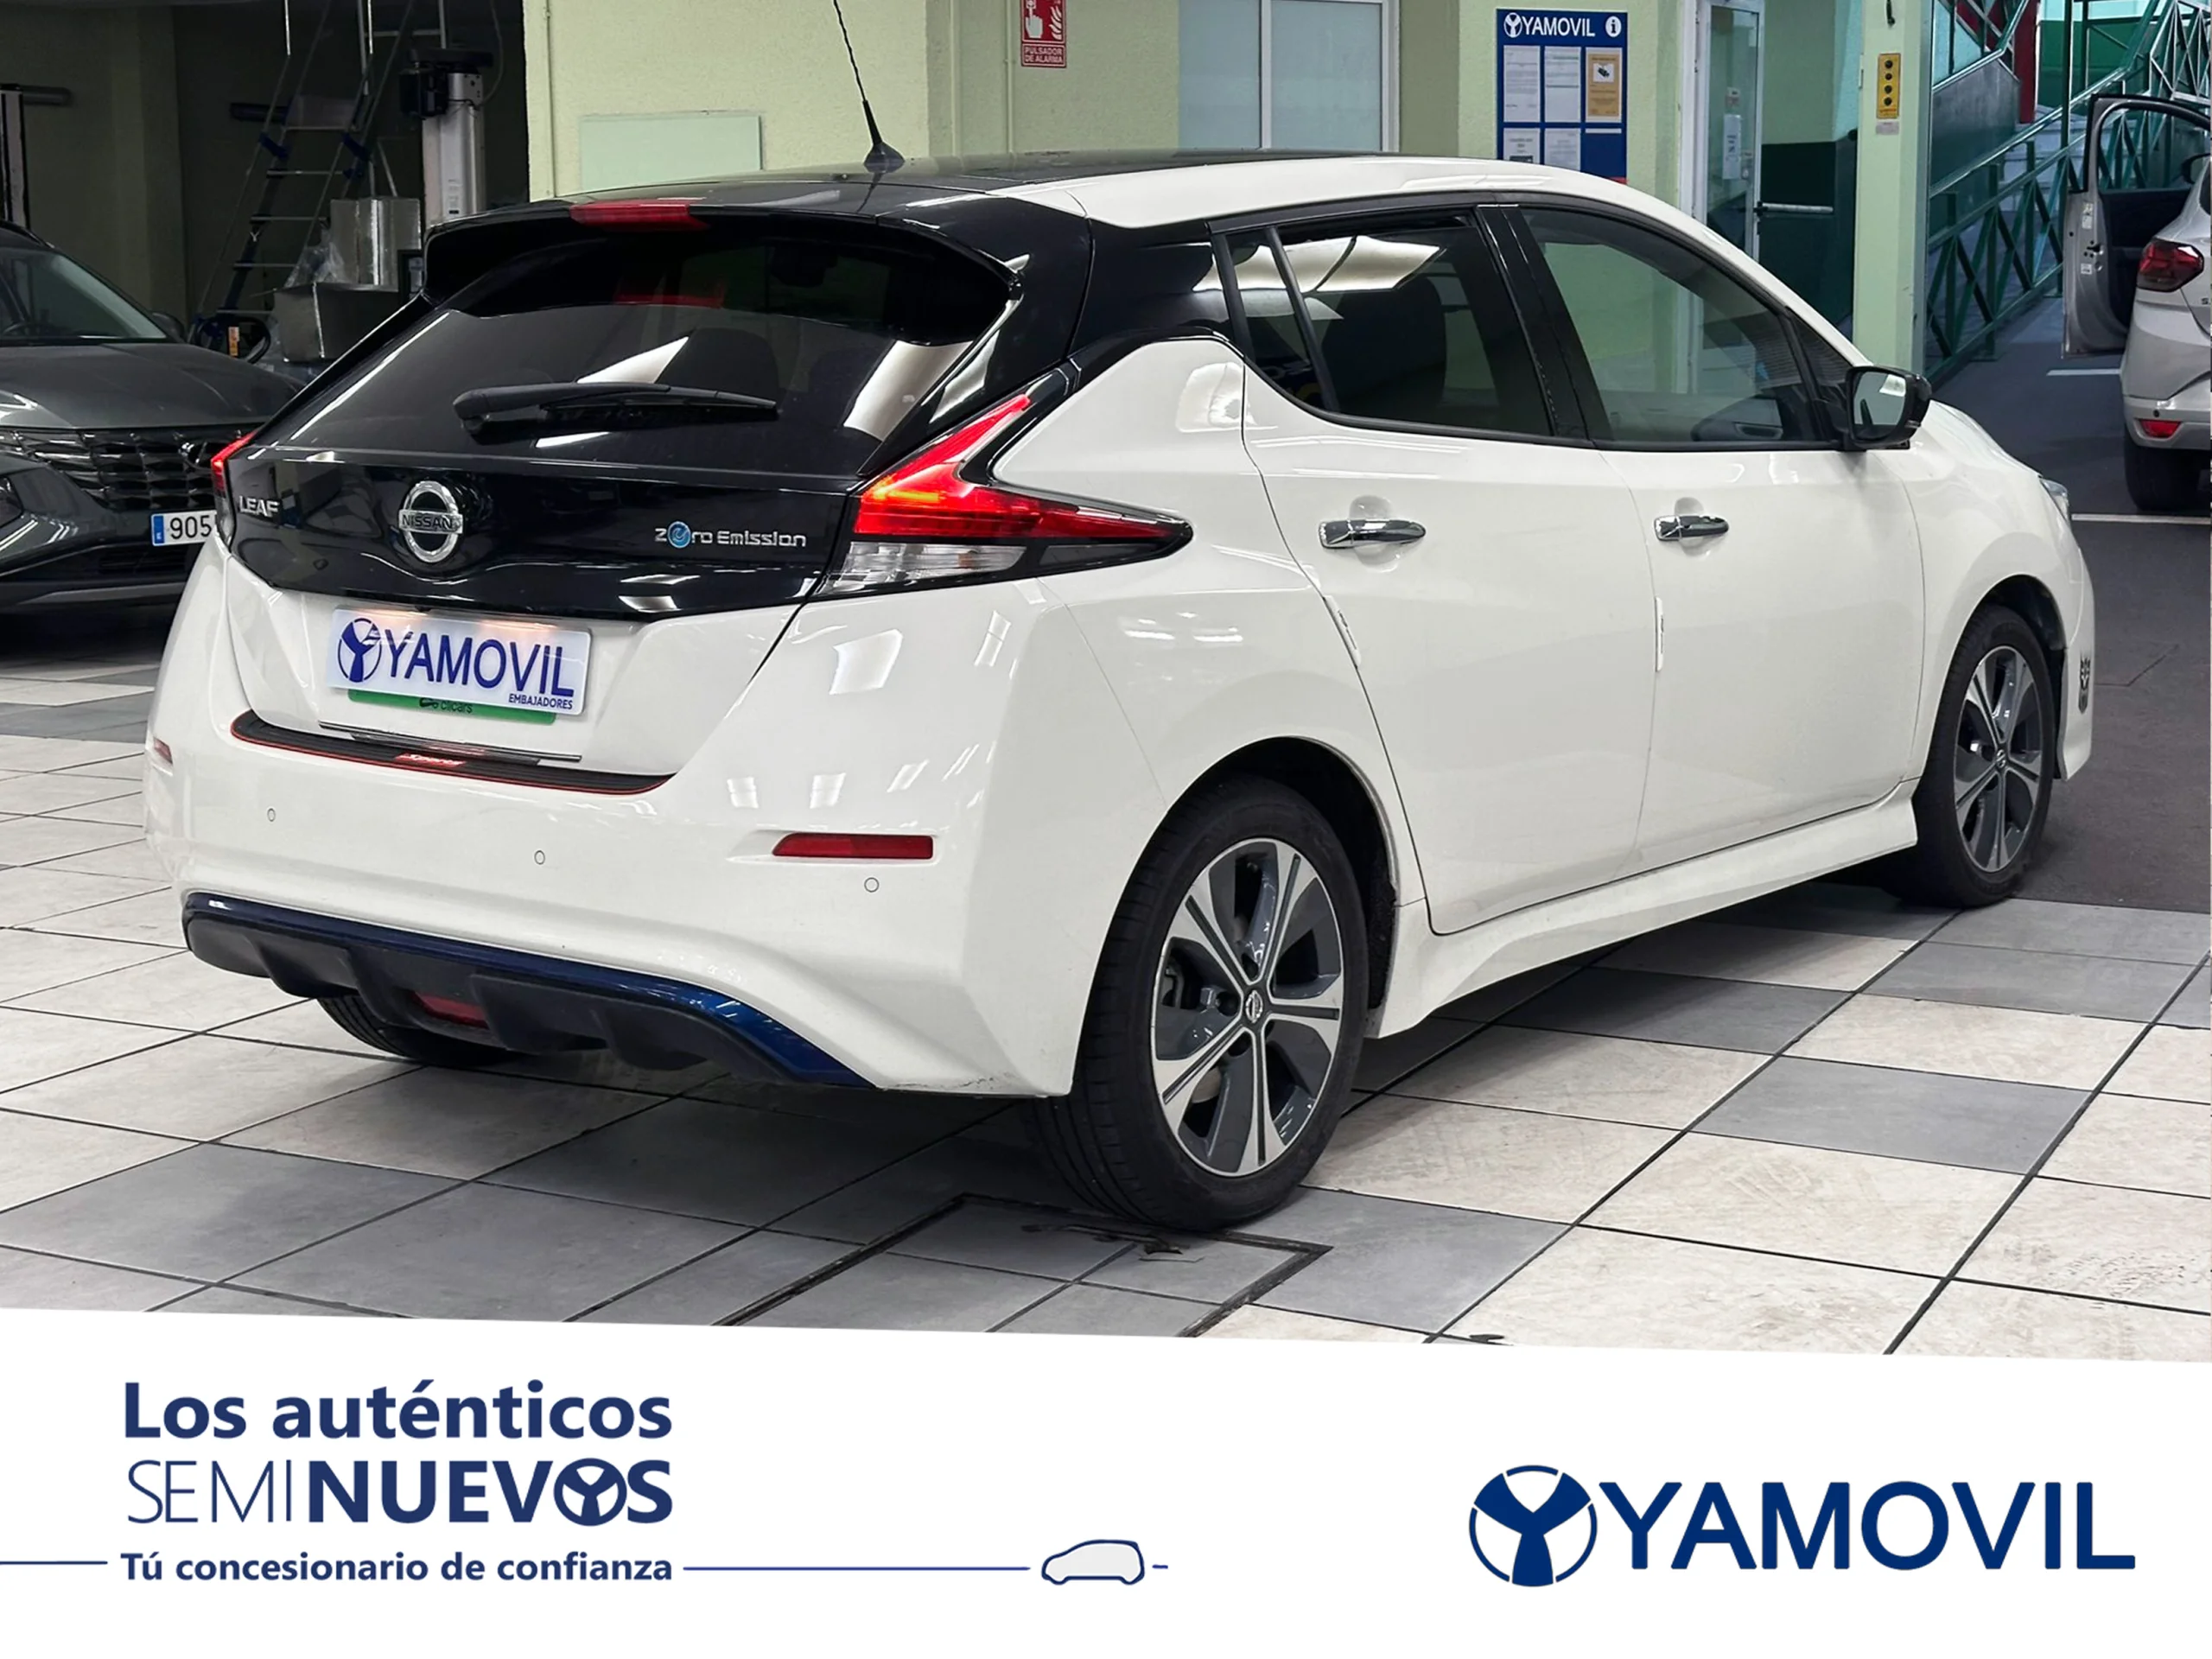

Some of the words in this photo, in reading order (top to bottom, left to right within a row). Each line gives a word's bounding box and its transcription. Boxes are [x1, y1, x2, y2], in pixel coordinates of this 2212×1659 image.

[1522, 16, 1596, 36] YAMOVIL
[1024, 47, 1063, 55] PULSADOR
[1035, 54, 1063, 63] ALARMA
[239, 495, 280, 518] LEAF
[170, 515, 218, 539] 905
[402, 514, 453, 531] NISSAN
[717, 530, 807, 547] Emission
[385, 629, 575, 697] YAMOVIL
[508, 693, 573, 709] EMBAJADORES
